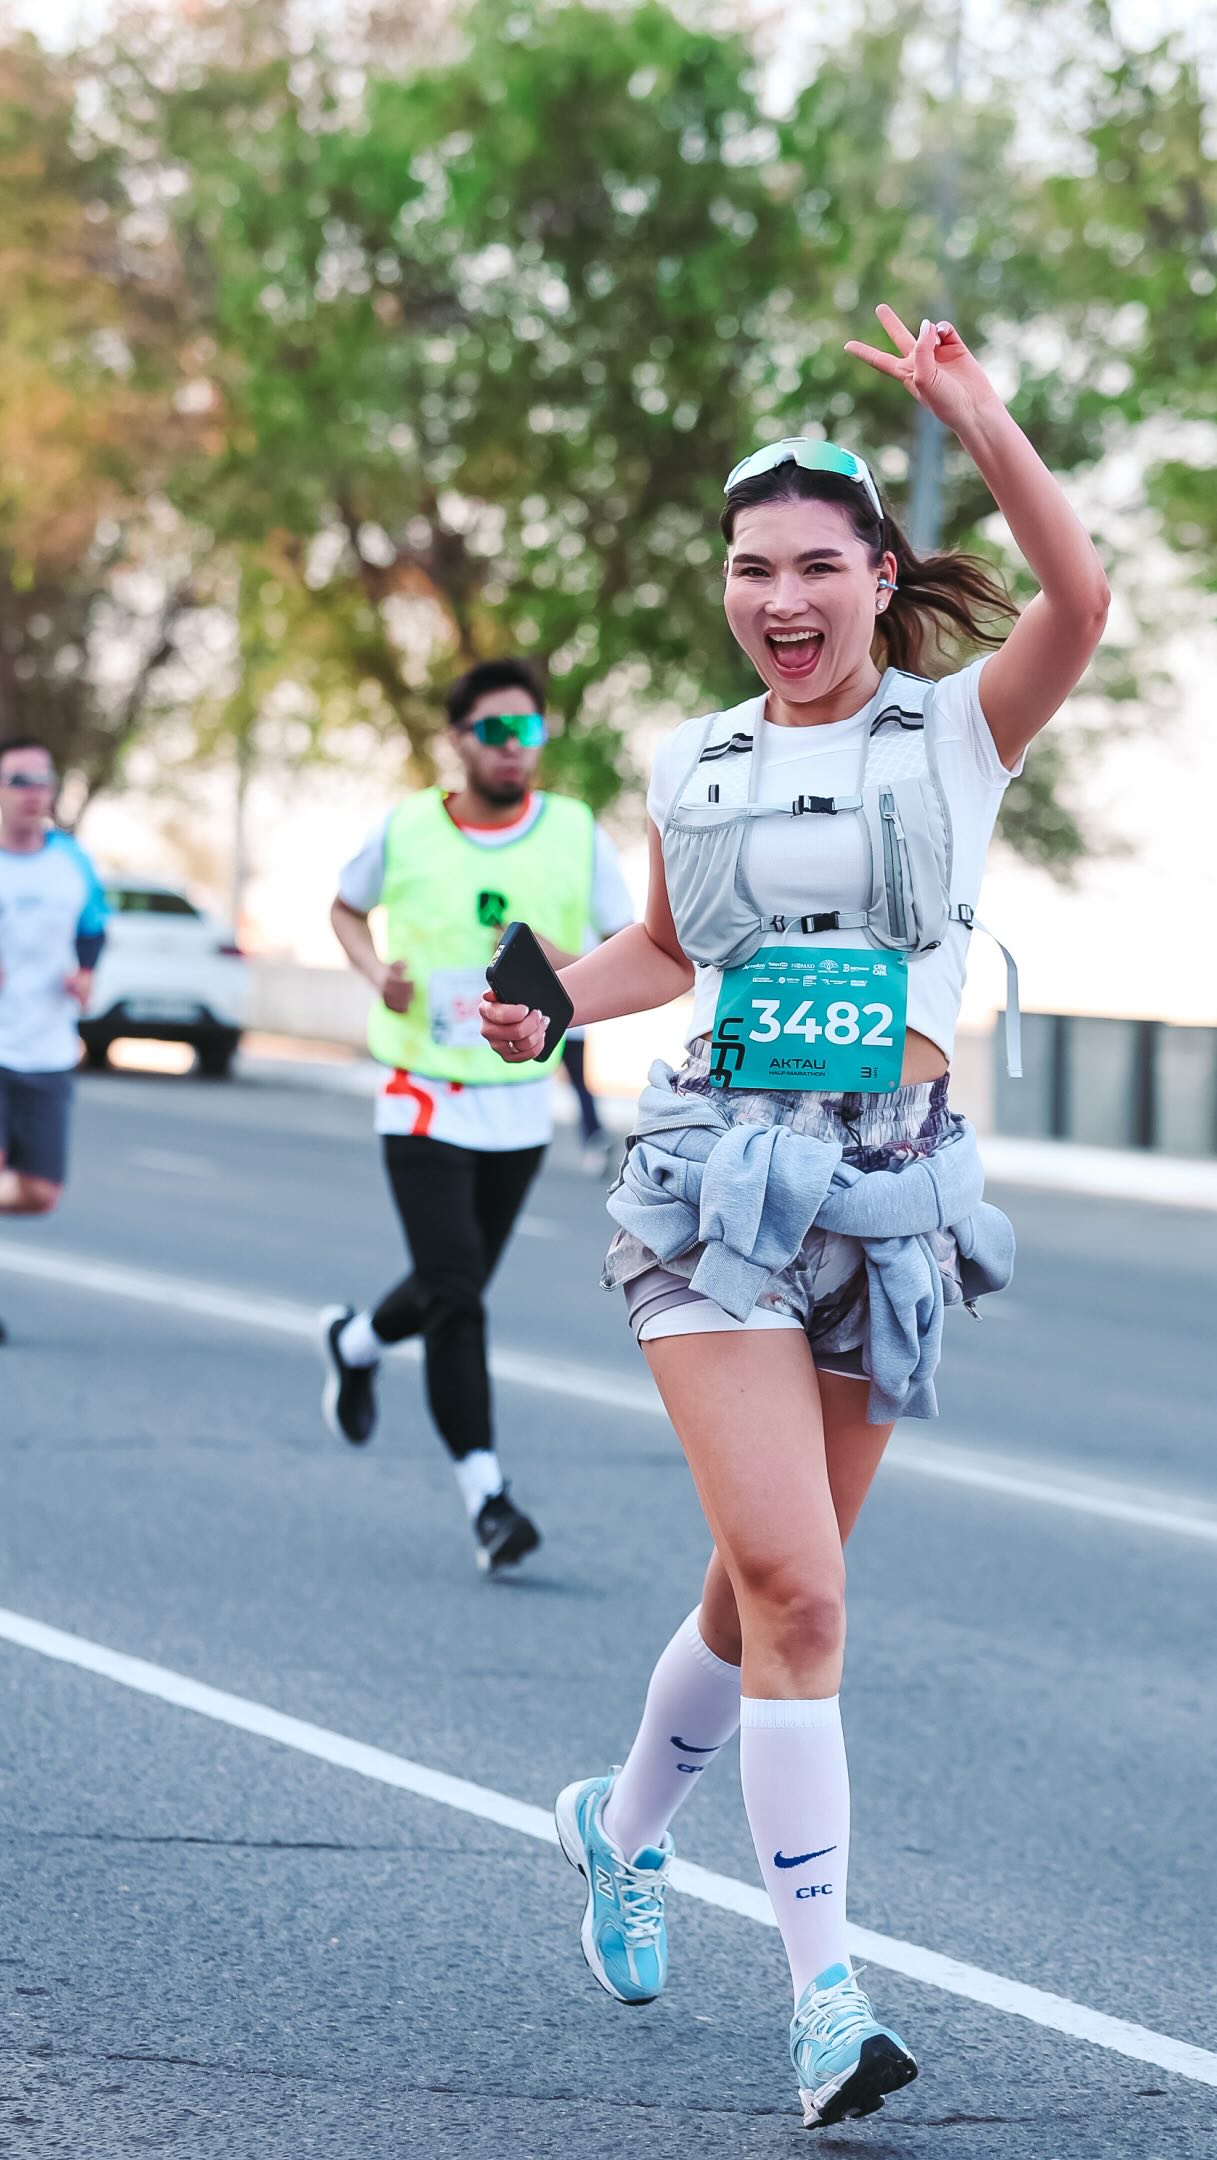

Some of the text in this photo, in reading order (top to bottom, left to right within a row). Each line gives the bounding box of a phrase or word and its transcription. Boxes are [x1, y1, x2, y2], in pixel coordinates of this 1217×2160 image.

[749, 999, 893, 1047] 3482
[769, 1058, 826, 1070] AKTAU
[676, 1763, 704, 1773] CF
[795, 1883, 833, 1899] CFC
